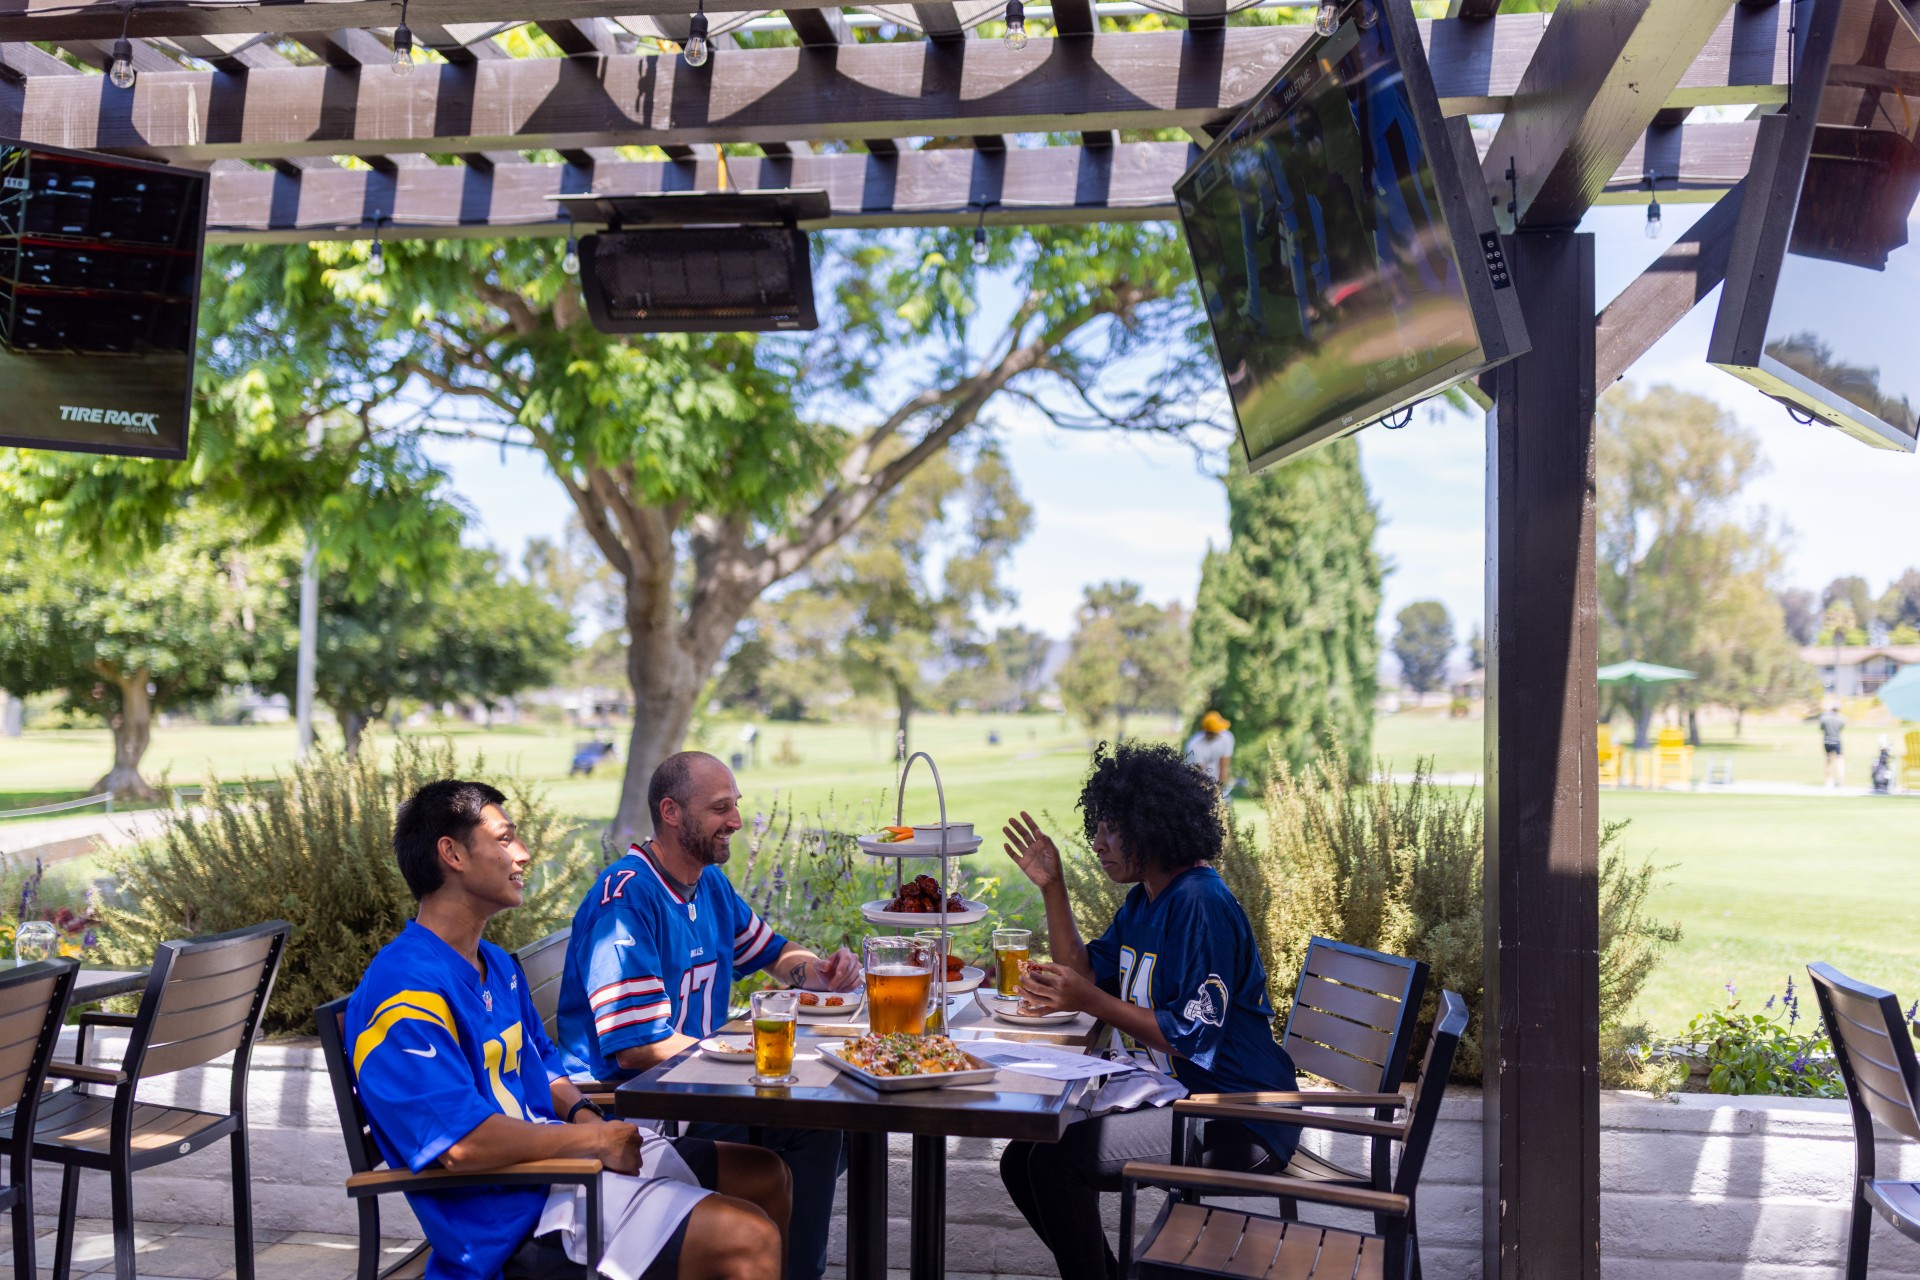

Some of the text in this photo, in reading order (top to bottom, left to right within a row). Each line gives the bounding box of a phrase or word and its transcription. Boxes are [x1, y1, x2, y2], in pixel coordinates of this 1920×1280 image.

[1282, 68, 1312, 104] HALFTIME
[60, 405, 158, 435] TIRE RACK
[601, 870, 636, 905] 17
[673, 960, 718, 1038] 17
